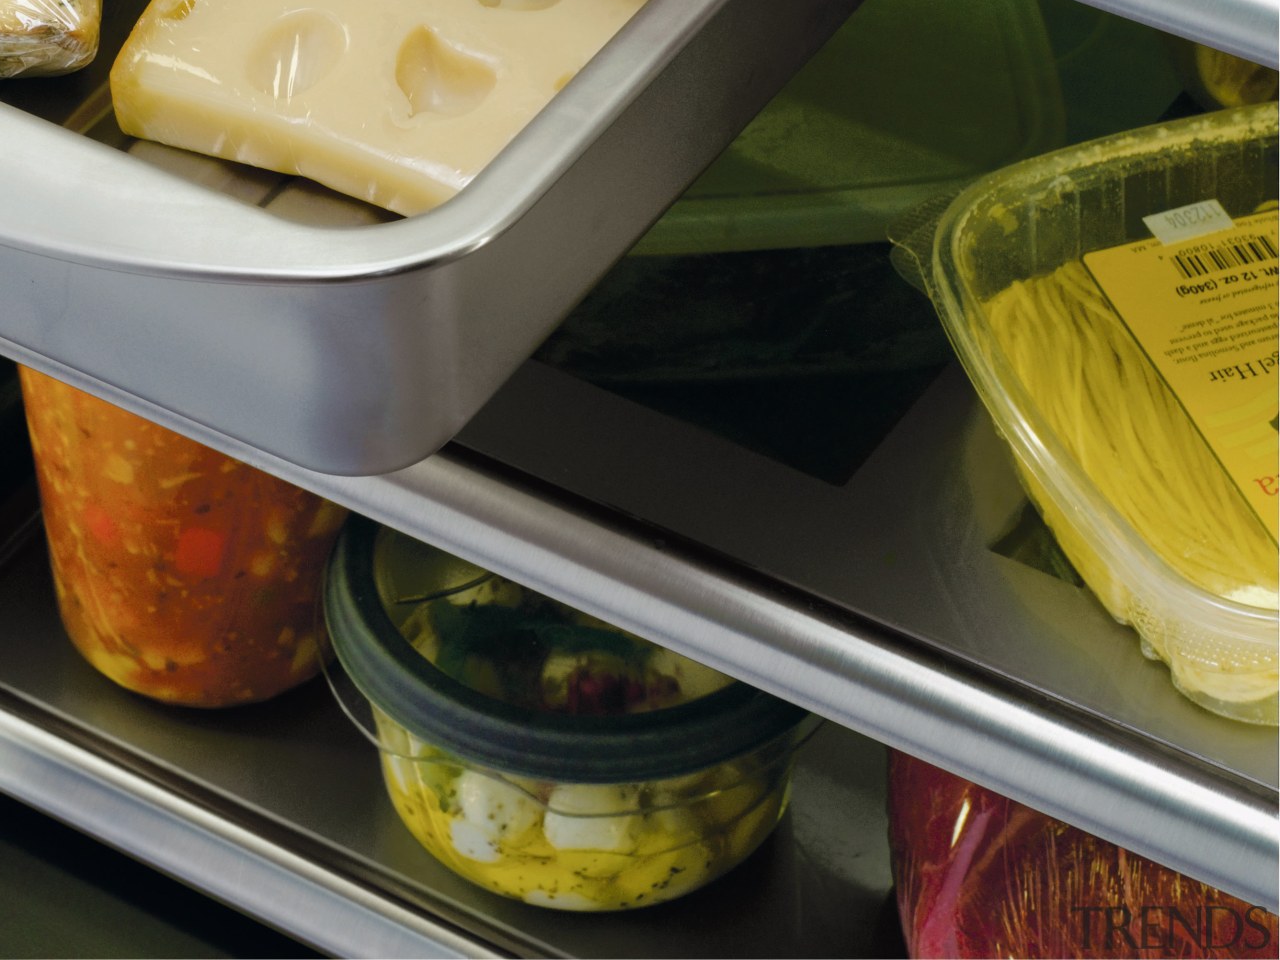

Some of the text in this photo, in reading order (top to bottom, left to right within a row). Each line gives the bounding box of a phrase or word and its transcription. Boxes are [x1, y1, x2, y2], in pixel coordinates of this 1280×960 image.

[1164, 204, 1221, 229] 112304
[1178, 242, 1214, 257] 10800
[1218, 275, 1239, 285] oz.
[1241, 271, 1258, 282] 12
[1175, 279, 1218, 298] (340g)
[1221, 313, 1233, 321] for
[1233, 305, 1266, 317] minutes
[1236, 314, 1269, 328] package
[1213, 325, 1234, 336] used
[1230, 322, 1277, 341] pasteurized
[1169, 331, 1201, 344] prevent
[1210, 336, 1228, 345] eggs
[1192, 341, 1208, 351] and
[1240, 340, 1256, 351] and
[1164, 348, 1185, 358] dash
[1198, 345, 1239, 359] Semolina
[1208, 362, 1258, 383] Hair
